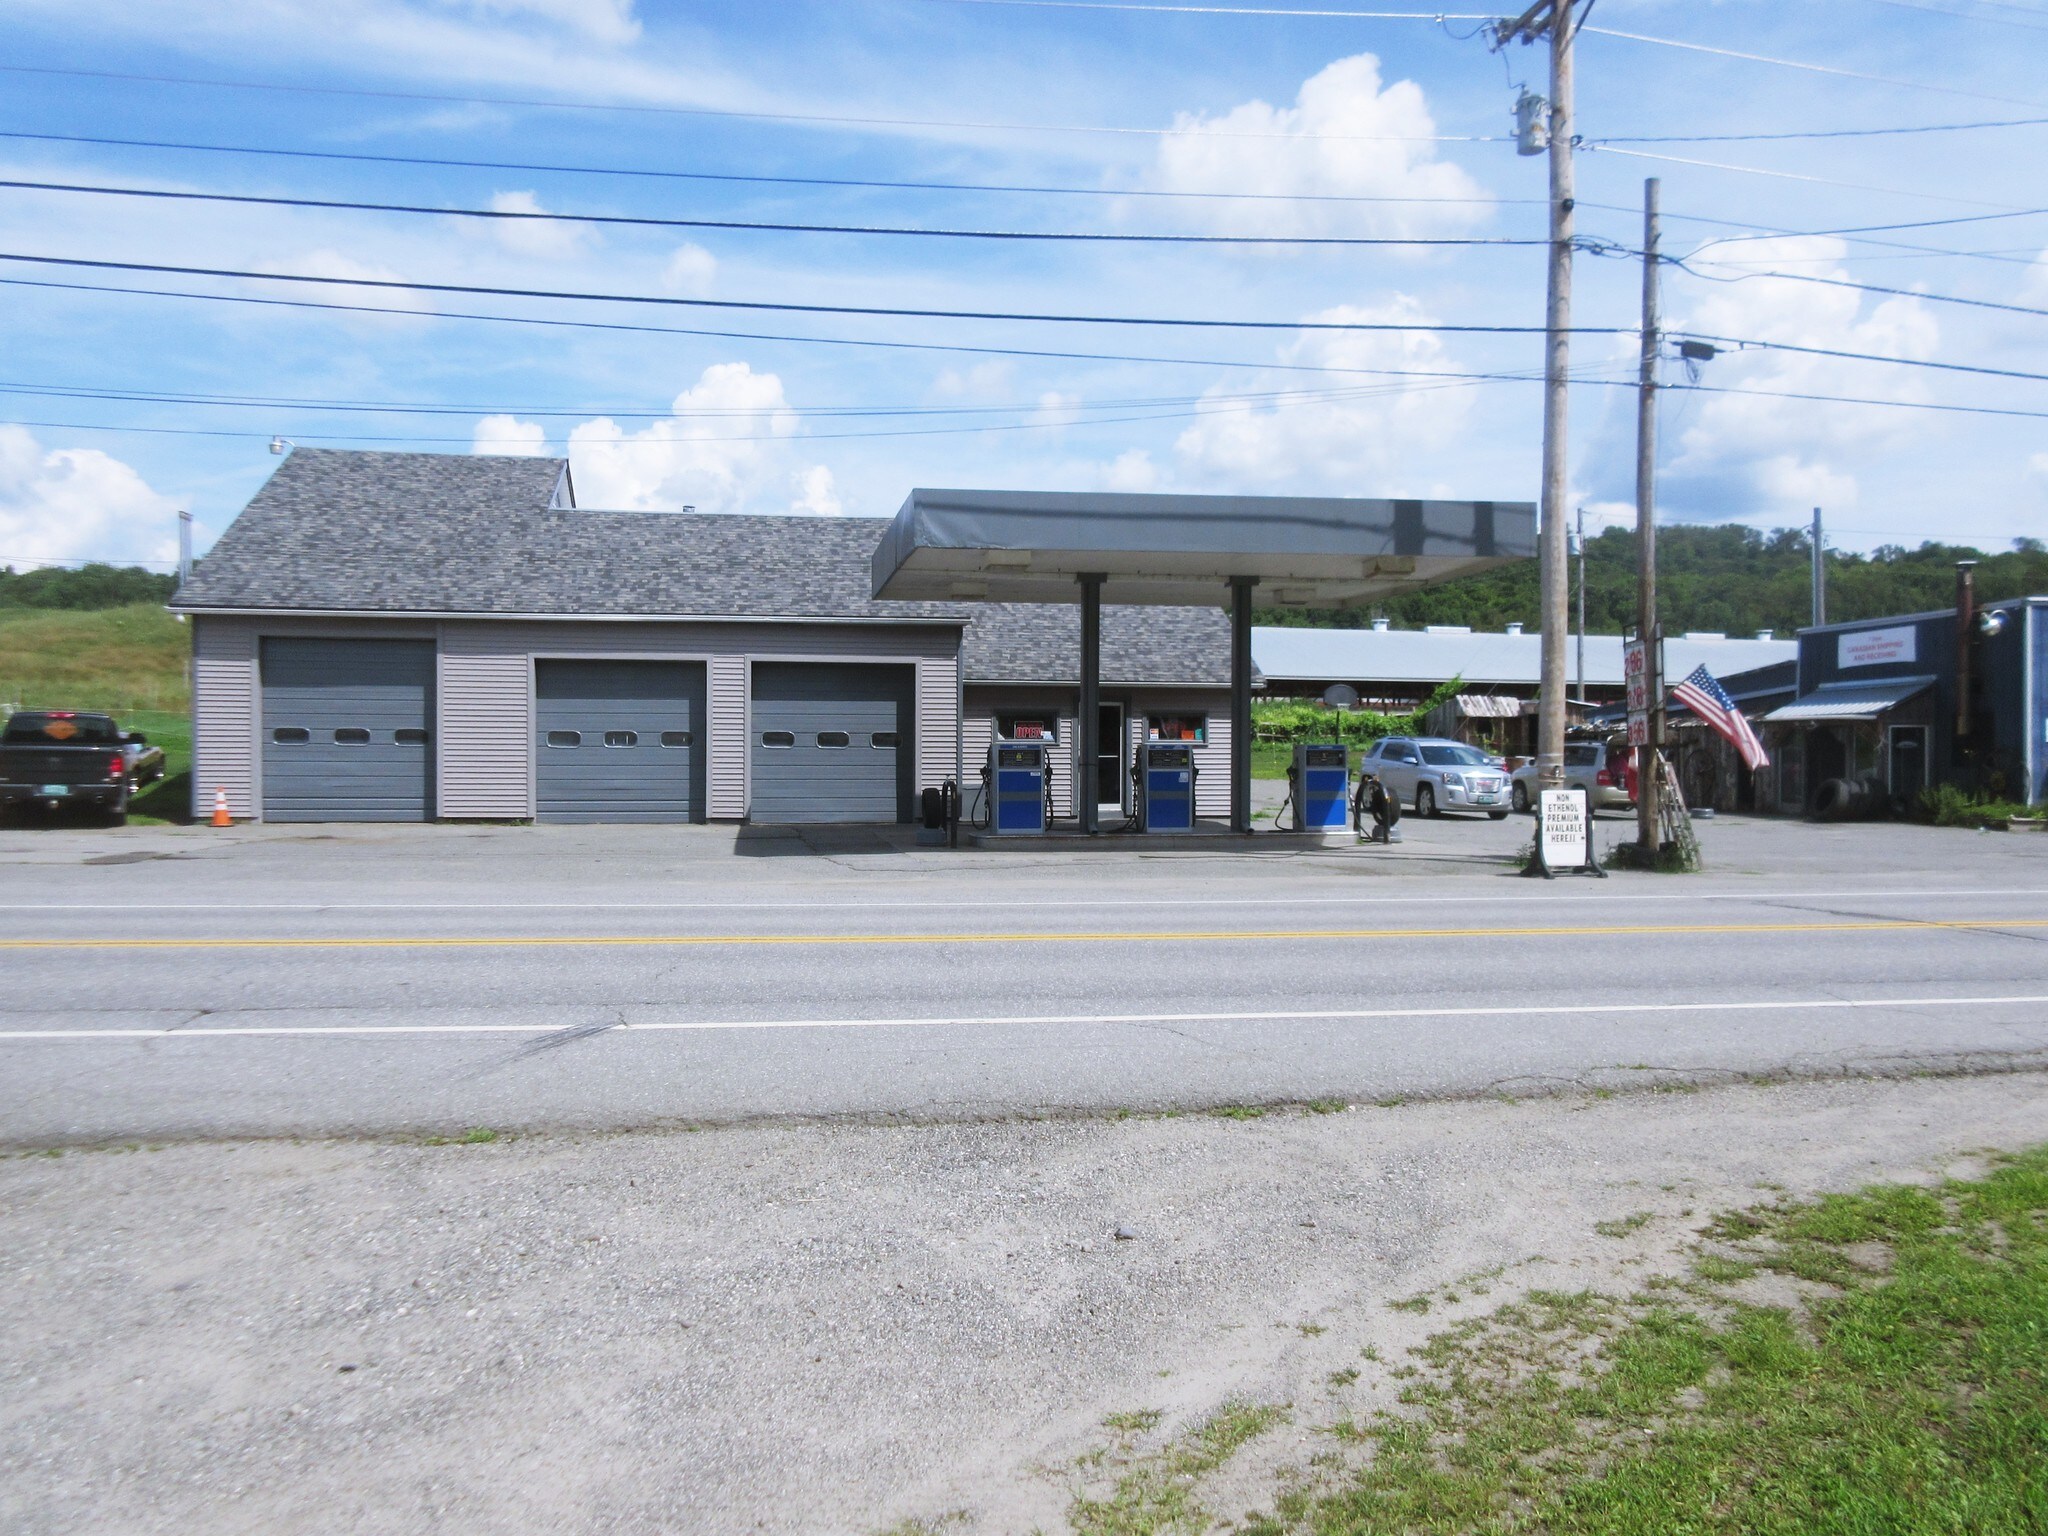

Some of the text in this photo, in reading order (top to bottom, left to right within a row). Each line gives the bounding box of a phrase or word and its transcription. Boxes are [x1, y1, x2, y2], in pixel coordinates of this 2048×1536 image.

[1016, 727, 1042, 738] OPEN
[1556, 794, 1570, 802] NON
[1548, 803, 1578, 812] ETHENOL
[1547, 814, 1580, 822] PREMIUM
[1546, 824, 1583, 832] AVAILABLE
